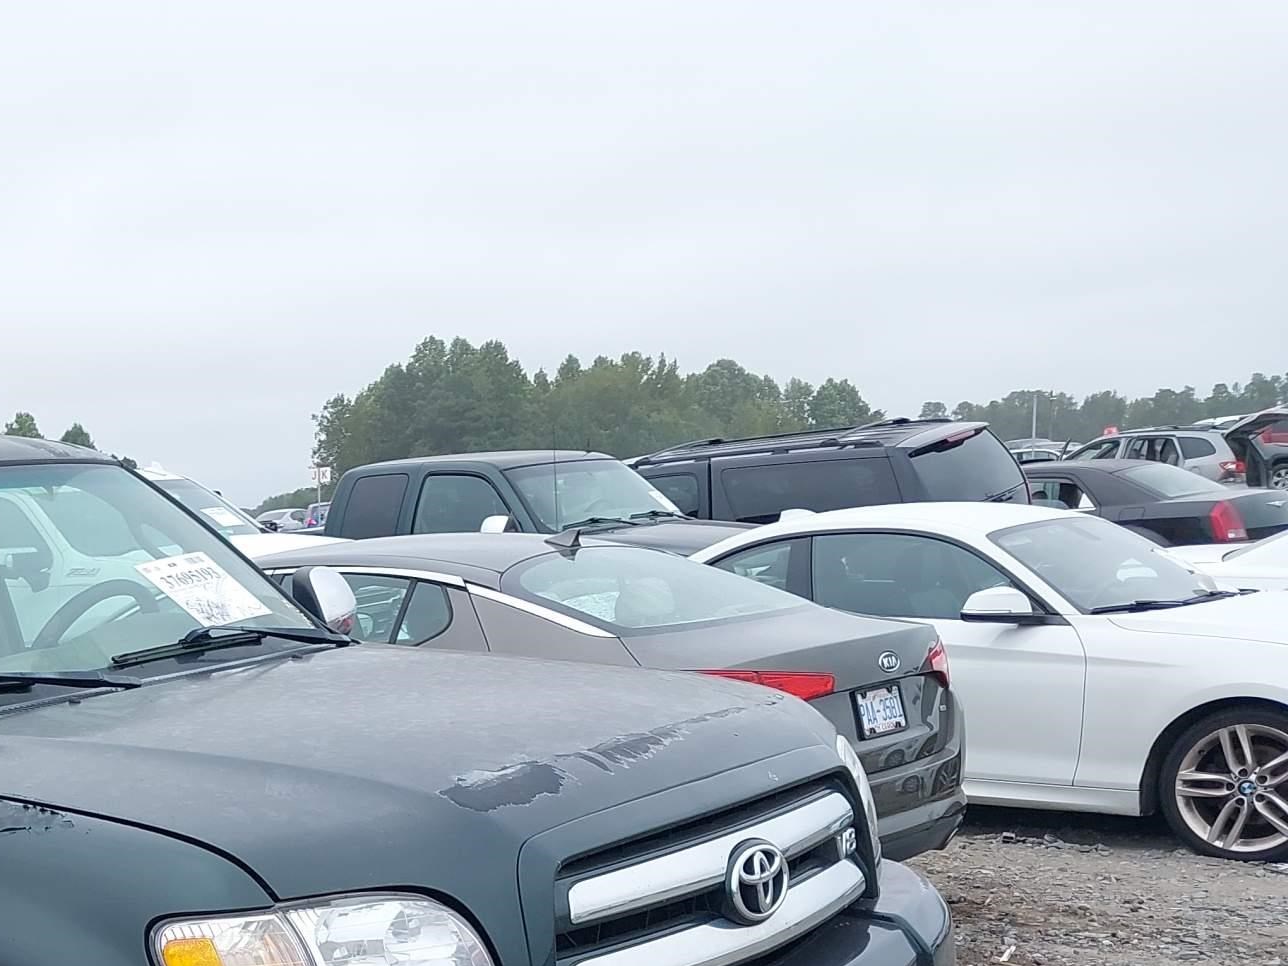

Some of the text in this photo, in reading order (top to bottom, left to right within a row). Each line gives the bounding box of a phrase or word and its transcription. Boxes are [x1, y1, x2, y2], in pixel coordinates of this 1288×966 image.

[321, 469, 329, 480] K
[160, 566, 221, 590] 37695193
[882, 655, 897, 669] KIA
[836, 827, 857, 860] V8
